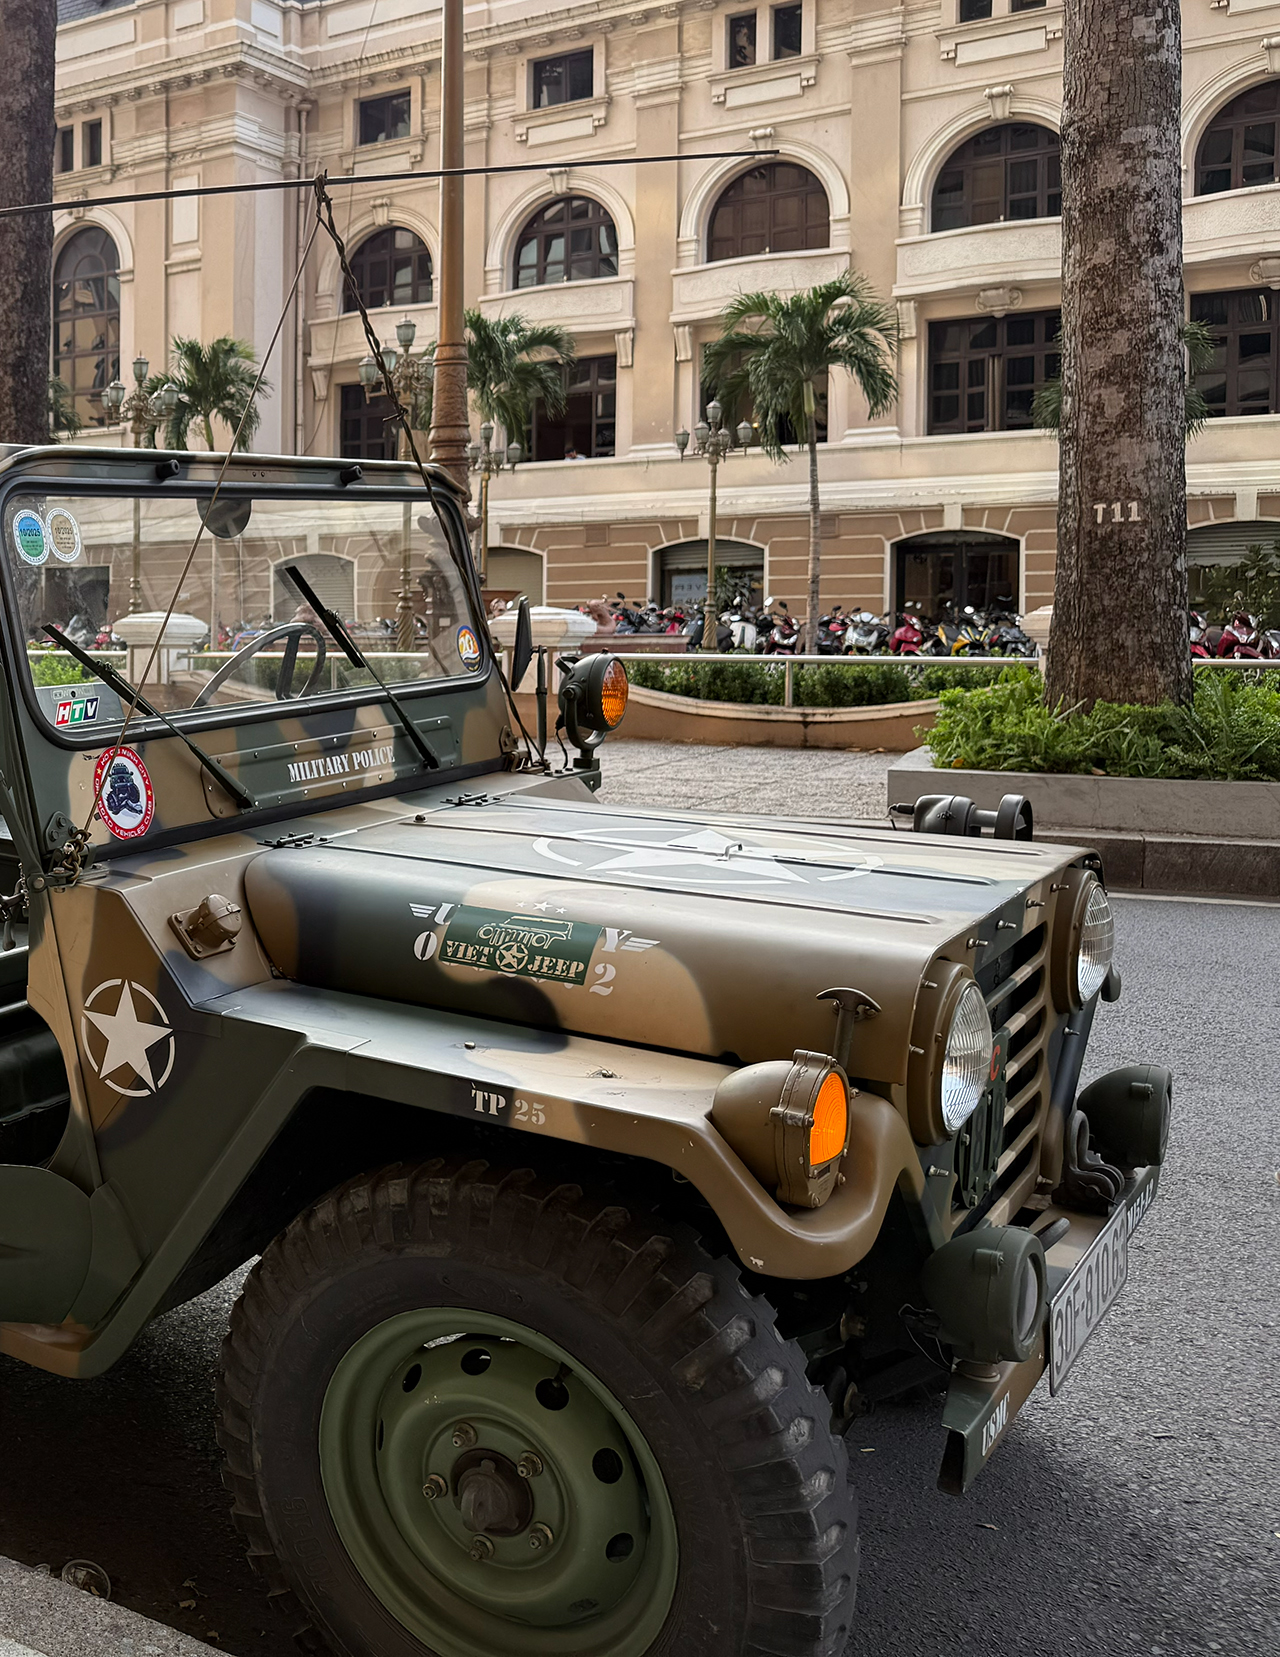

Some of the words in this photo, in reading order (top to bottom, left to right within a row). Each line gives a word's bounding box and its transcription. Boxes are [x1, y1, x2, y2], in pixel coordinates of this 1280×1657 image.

[19, 528, 41, 537] 10/2025
[57, 701, 97, 722] HTV
[138, 764, 150, 785] CITY
[287, 754, 350, 783] MILITARY
[351, 745, 396, 770] POLICE
[114, 824, 145, 838] VEHICLES
[446, 940, 493, 963] VIET
[527, 955, 585, 978] JEEP
[471, 1088, 506, 1116] TP
[514, 1099, 546, 1125] 25
[982, 1389, 1010, 1457] USMC
